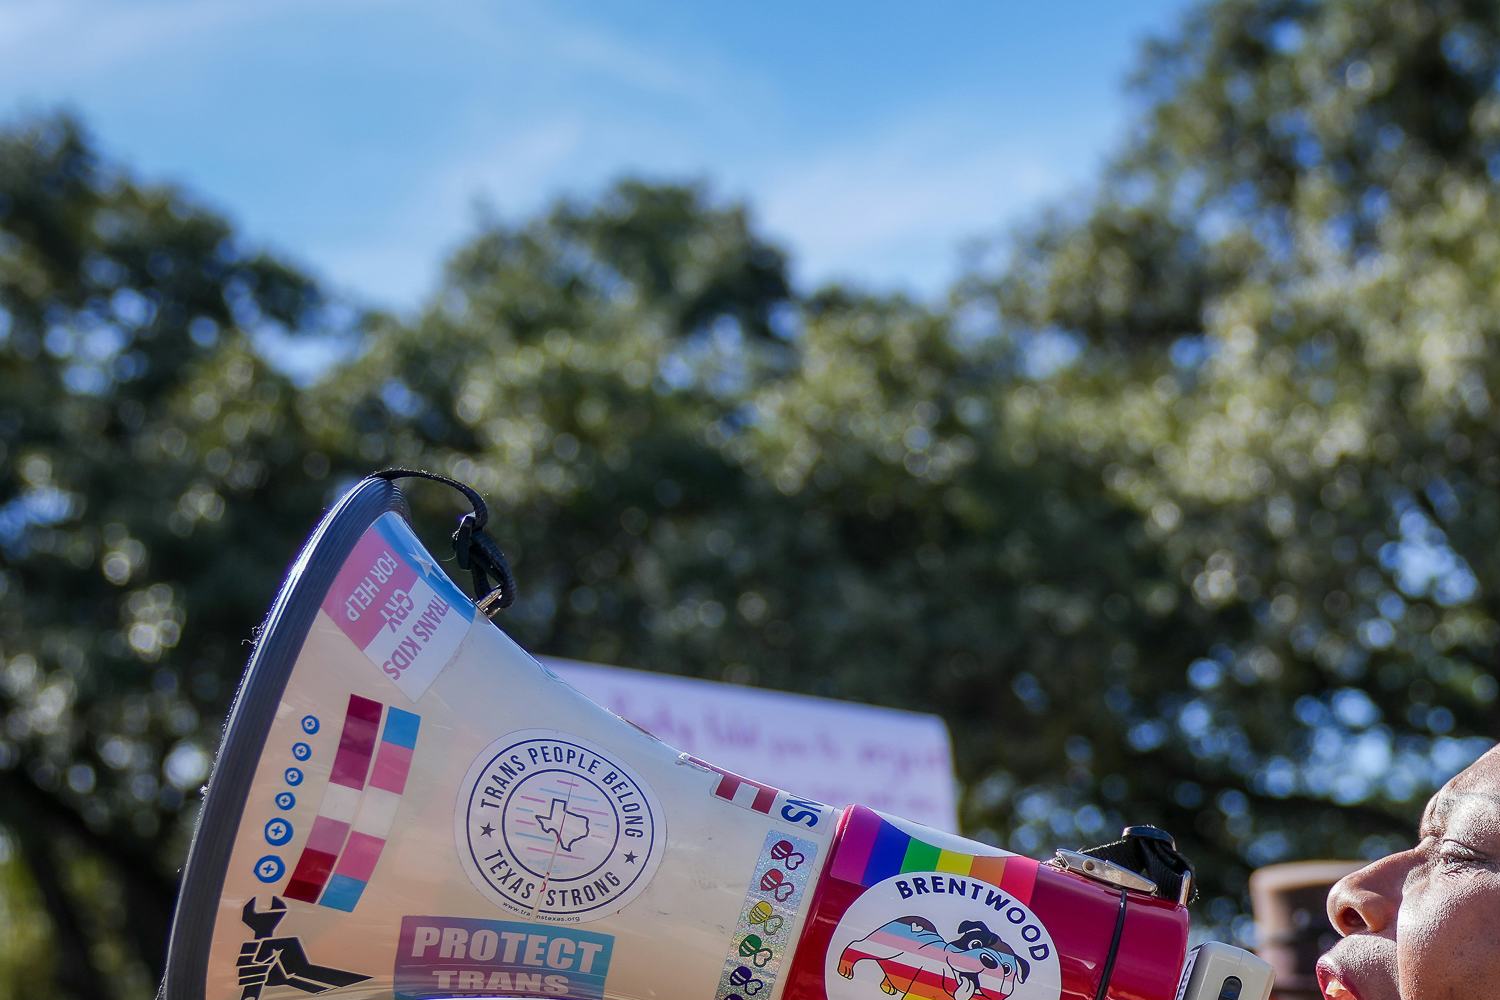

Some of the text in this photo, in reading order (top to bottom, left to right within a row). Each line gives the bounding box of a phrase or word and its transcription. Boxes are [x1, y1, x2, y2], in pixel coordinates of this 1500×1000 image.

[344, 550, 399, 622] FOR HELP
[382, 594, 450, 680] TRANS KIDS
[480, 745, 644, 838] TRANS PEOPLE BELONG
[484, 848, 621, 907] TEXAS STRONG
[411, 926, 604, 974] PROTECT
[895, 875, 1050, 961] BRENTWOOD
[432, 970, 570, 995] TRANS
